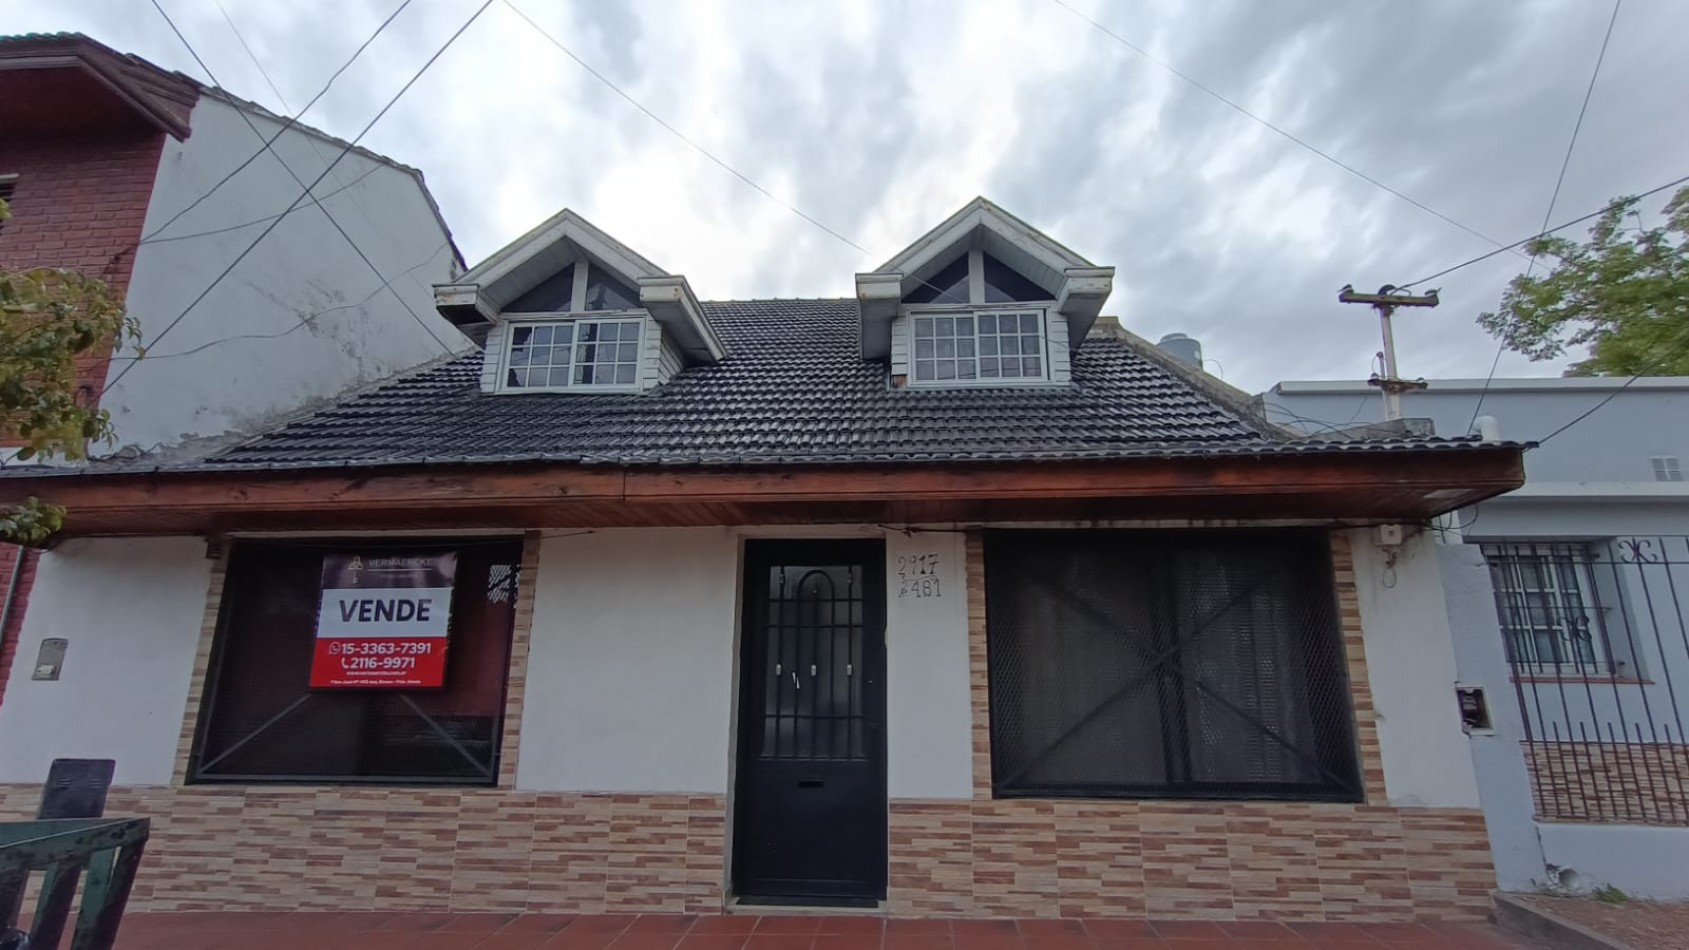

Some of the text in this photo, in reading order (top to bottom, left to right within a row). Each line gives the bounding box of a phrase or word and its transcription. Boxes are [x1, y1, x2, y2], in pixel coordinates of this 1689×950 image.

[898, 554, 939, 575] 2917
[339, 599, 432, 622] VENDE
[342, 642, 432, 655] 15-3363-7391
[351, 657, 415, 669] 2116-9971
